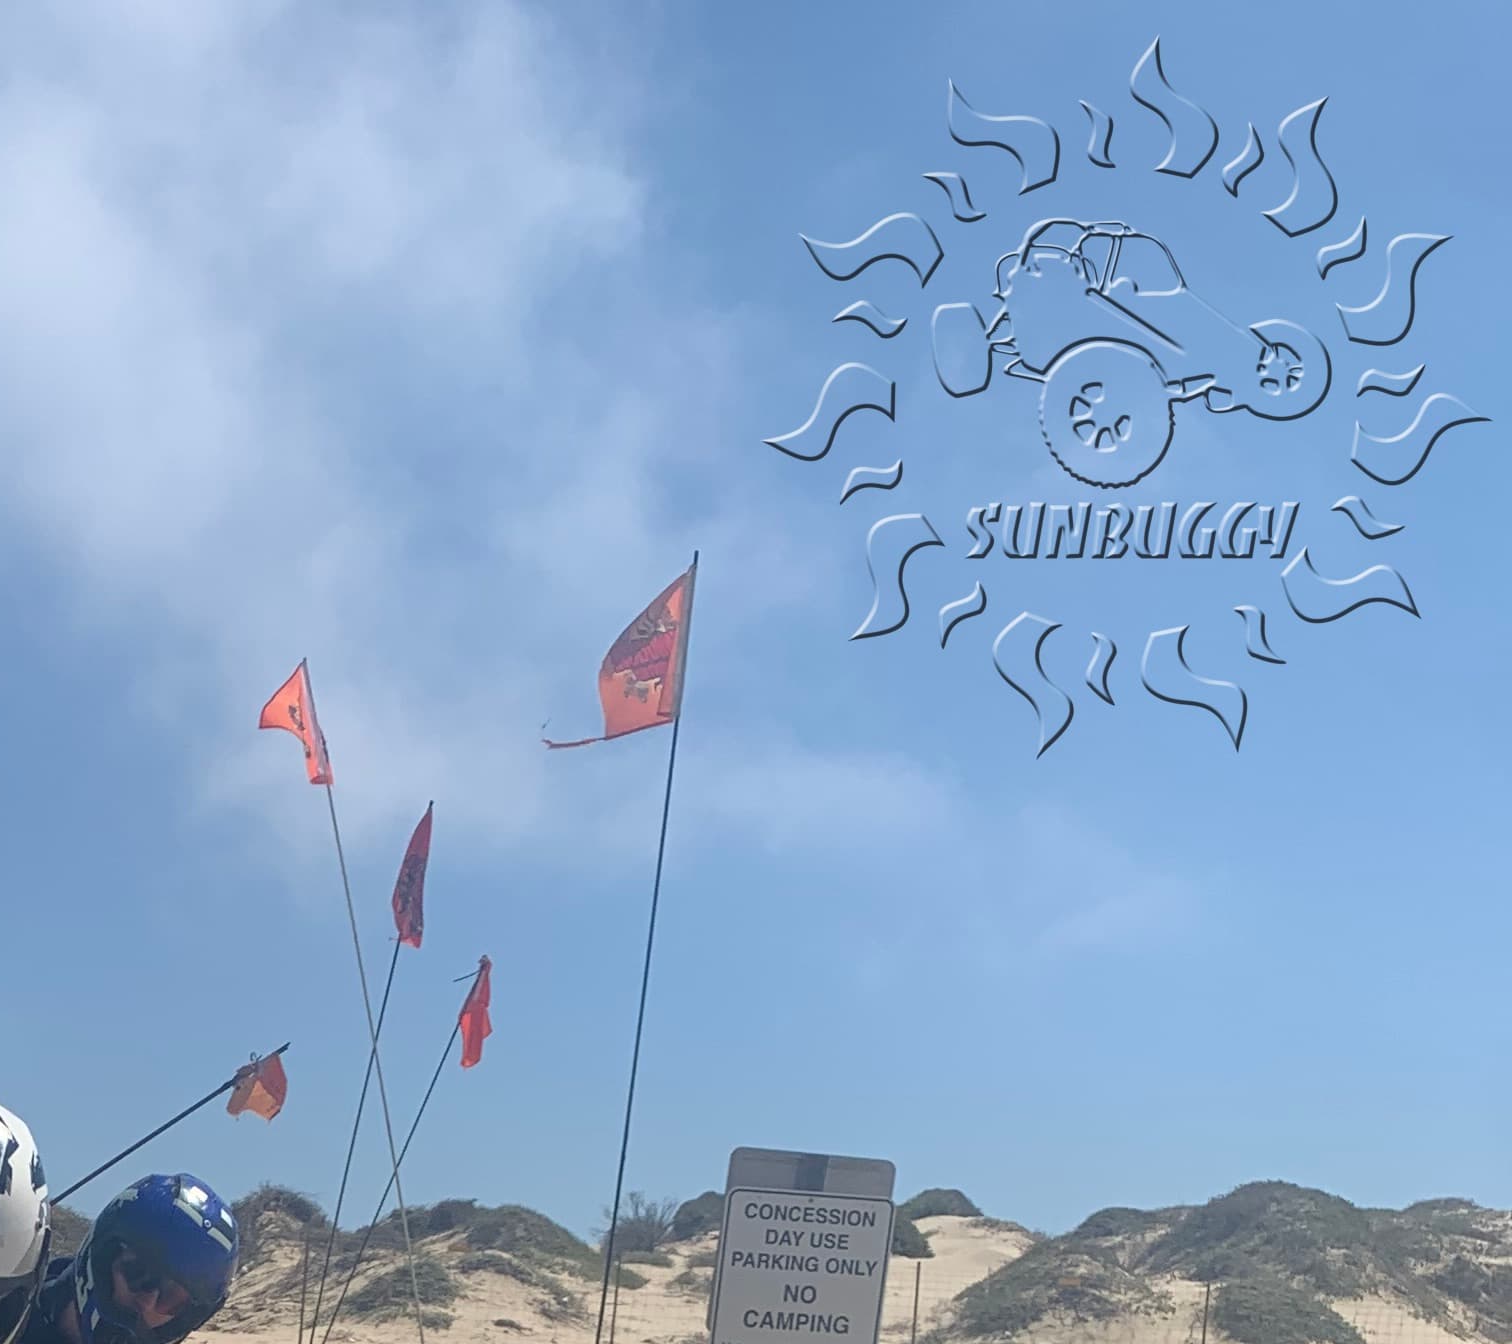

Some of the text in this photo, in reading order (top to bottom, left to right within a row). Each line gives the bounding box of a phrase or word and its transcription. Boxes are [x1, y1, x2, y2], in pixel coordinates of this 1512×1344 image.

[744, 1202, 876, 1227] CONCESSION
[765, 1229, 849, 1250] DAY USE
[731, 1251, 877, 1276] PARKING ONLY
[783, 1284, 817, 1304] NO
[743, 1309, 849, 1334] CAMPING
